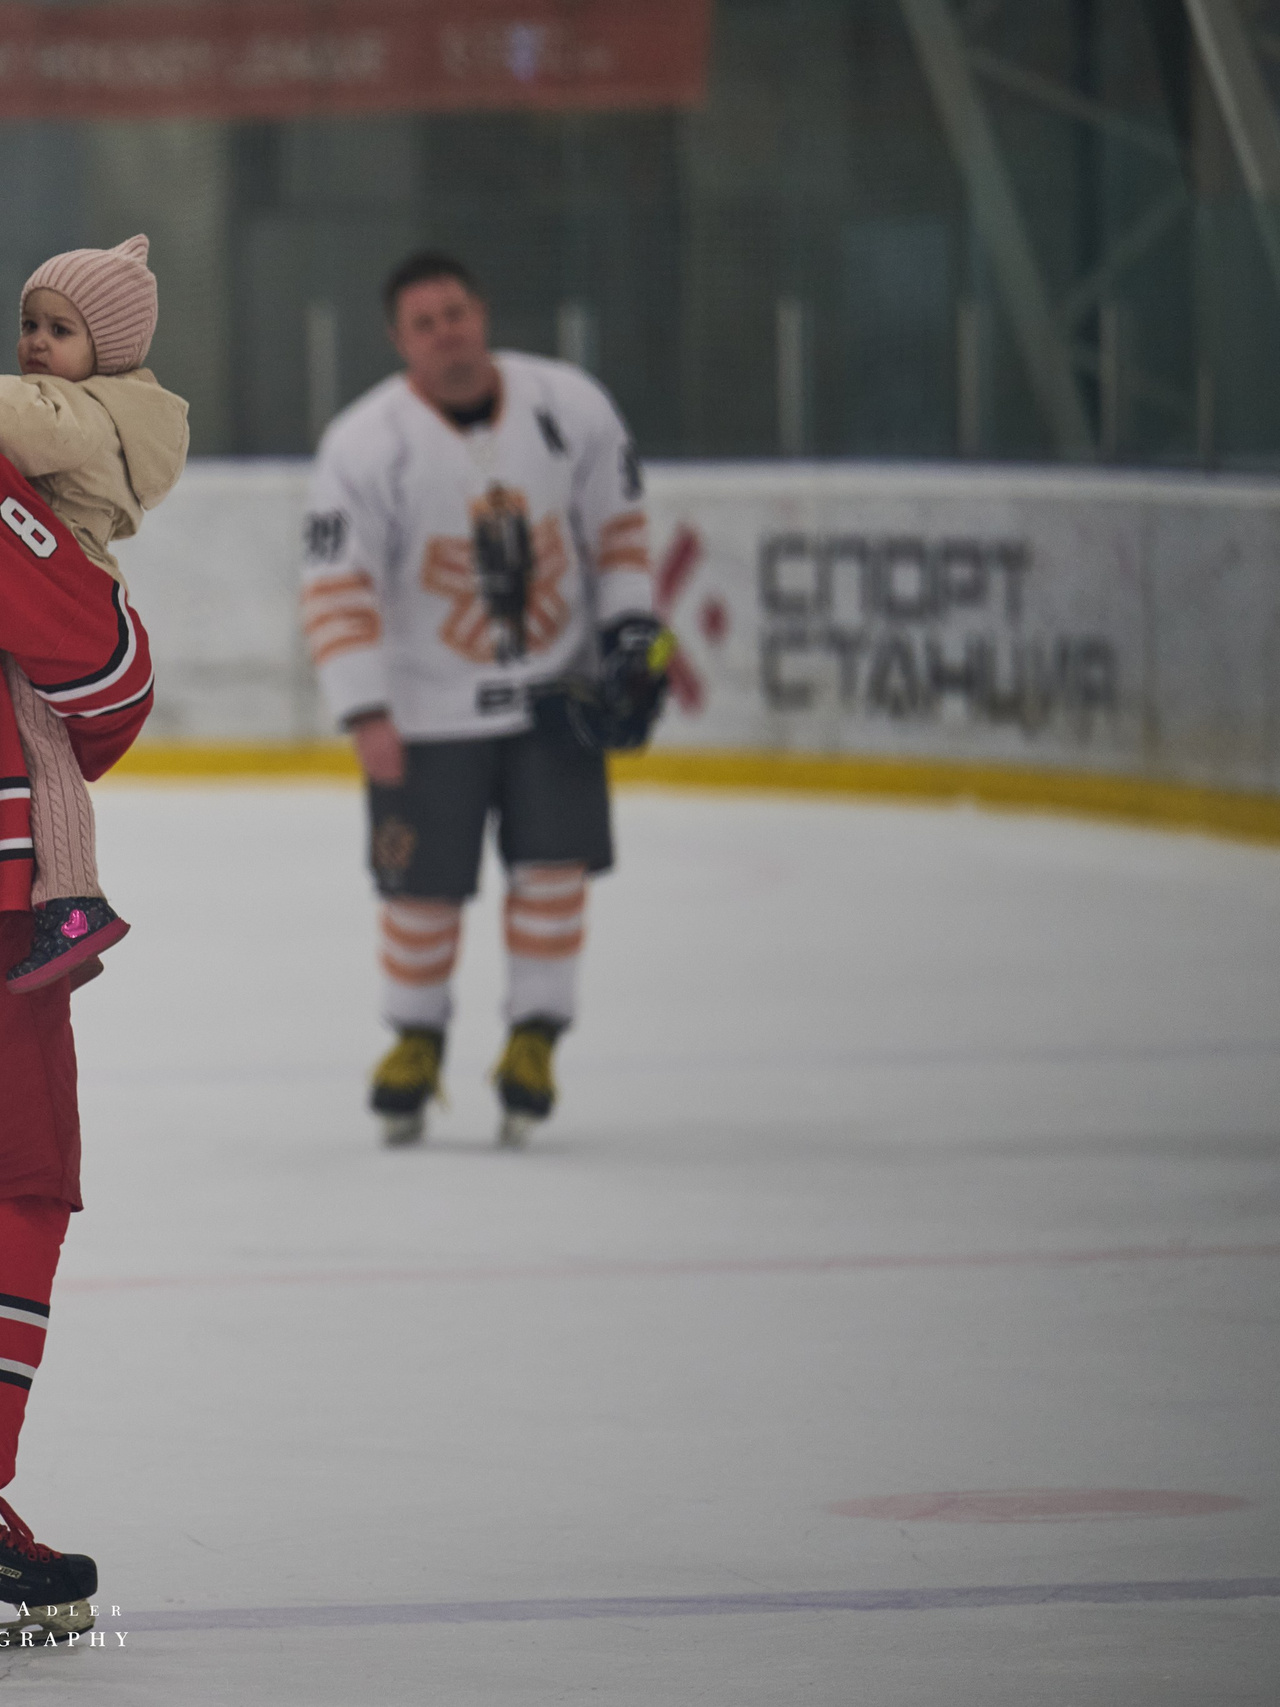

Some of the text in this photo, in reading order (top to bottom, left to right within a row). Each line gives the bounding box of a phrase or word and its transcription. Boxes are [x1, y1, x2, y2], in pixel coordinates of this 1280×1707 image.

[0, 496, 58, 559] 8
[757, 530, 1034, 622] СПОРТ
[757, 626, 1118, 740] СТАНЦИЯ
